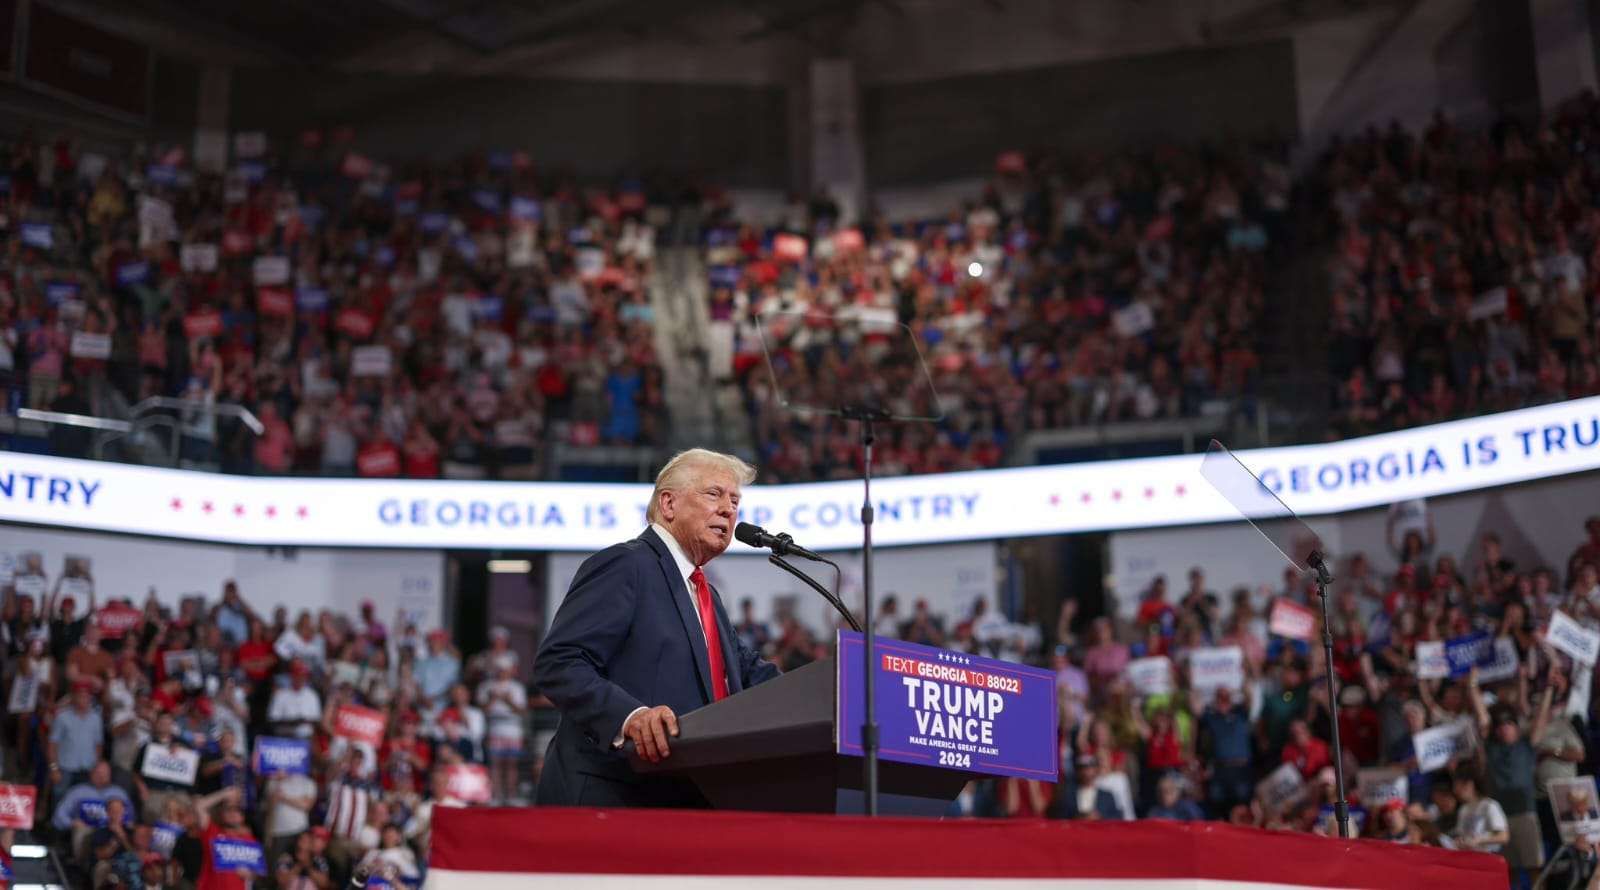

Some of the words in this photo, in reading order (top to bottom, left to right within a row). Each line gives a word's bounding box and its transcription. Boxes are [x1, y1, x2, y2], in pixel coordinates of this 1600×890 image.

[1257, 446, 1445, 496] GEORGIA
[1462, 437, 1498, 468] IS
[1515, 419, 1600, 457] TRU
[378, 498, 566, 527] GEORGIA
[583, 502, 617, 528] IS
[886, 655, 915, 674] TEXT
[917, 661, 968, 683] GEORGIA
[970, 671, 985, 686] TO
[987, 674, 1019, 693] 88022
[902, 676, 1004, 721] TRUMP
[915, 709, 993, 745] VANCE
[909, 735, 928, 746] MAKE
[928, 738, 956, 750] AMERICA
[957, 743, 977, 753] GREAT
[978, 746, 999, 756] AGAIN!
[939, 750, 971, 768] 2024
